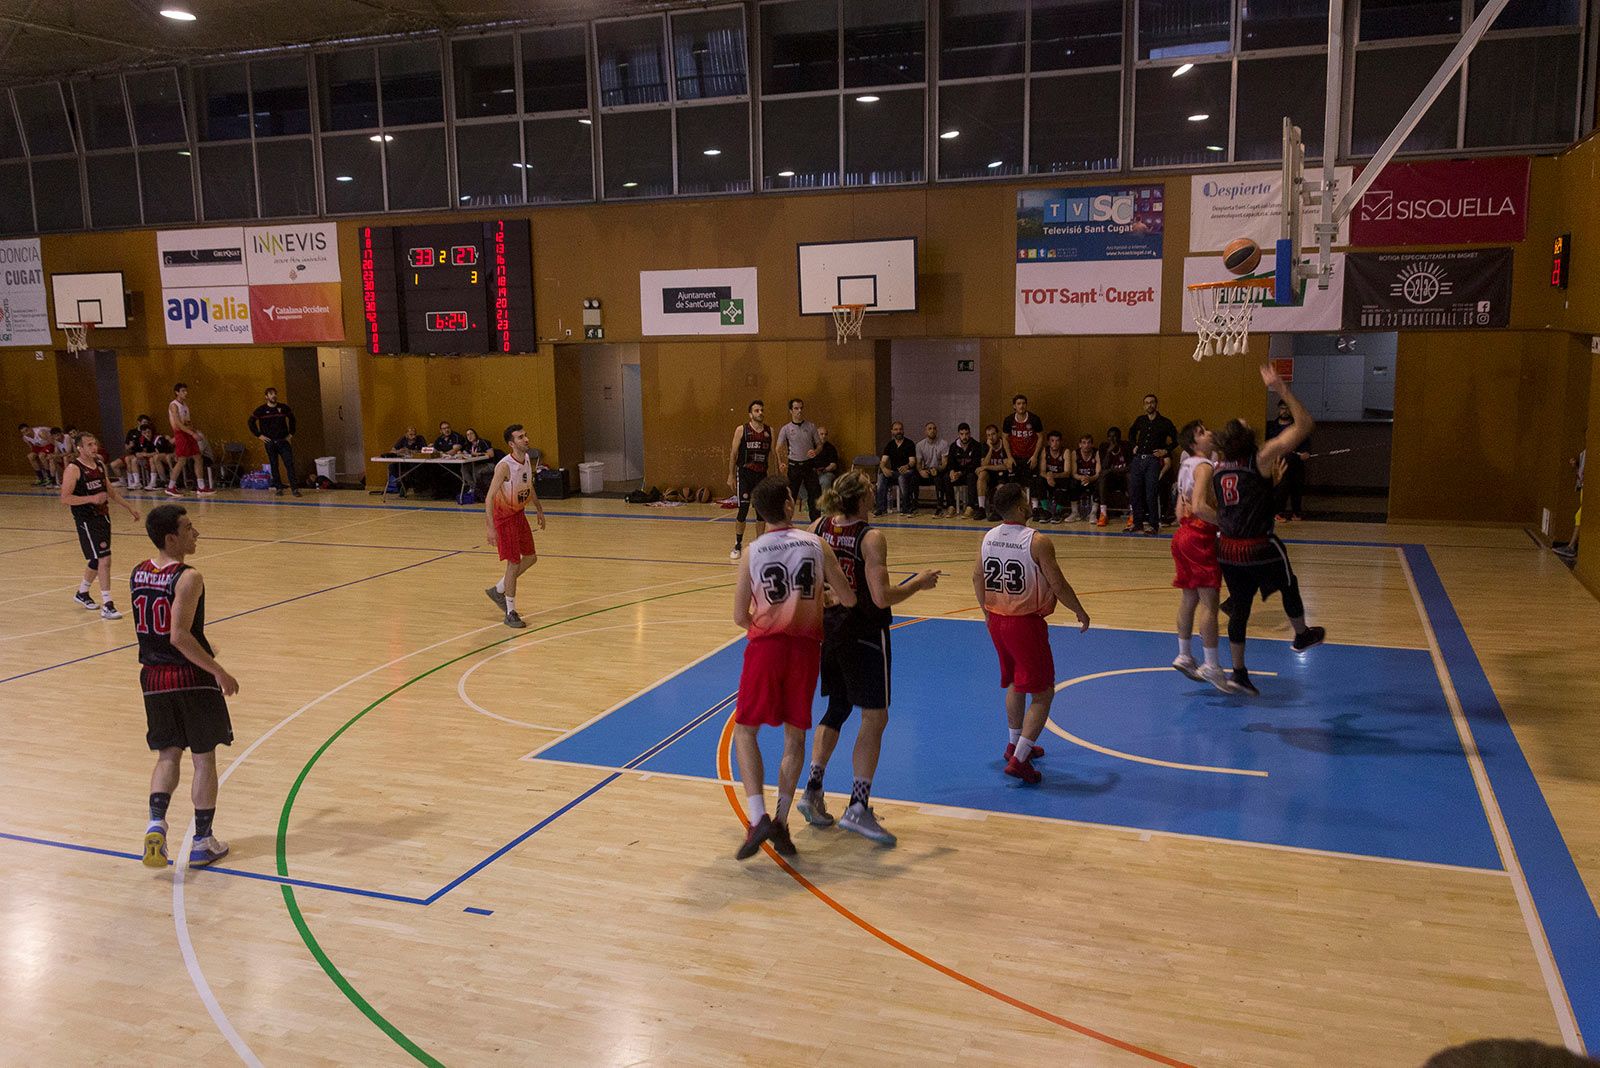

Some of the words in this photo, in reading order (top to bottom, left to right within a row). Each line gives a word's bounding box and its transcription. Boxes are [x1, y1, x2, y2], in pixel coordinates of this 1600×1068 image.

[1203, 181, 1271, 199] Despierta
[1396, 197, 1515, 219] SISQUELLA
[1043, 226, 1082, 236] Televisió
[1084, 225, 1104, 234] Sant
[1107, 224, 1133, 234] Cugat
[253, 231, 327, 256] INNEVIS
[416, 249, 433, 266] 33
[439, 250, 446, 263] 2
[456, 247, 474, 265] 27
[5, 269, 41, 286] CUGAT
[470, 270, 478, 284] 3
[675, 301, 685, 309] de
[677, 291, 717, 301] Ajuntament
[1105, 286, 1155, 307] Cugat
[213, 324, 229, 333] Sant
[230, 322, 249, 334] Cugat
[760, 557, 816, 605] 34
[984, 556, 1026, 595] 23
[133, 594, 172, 636] 10
